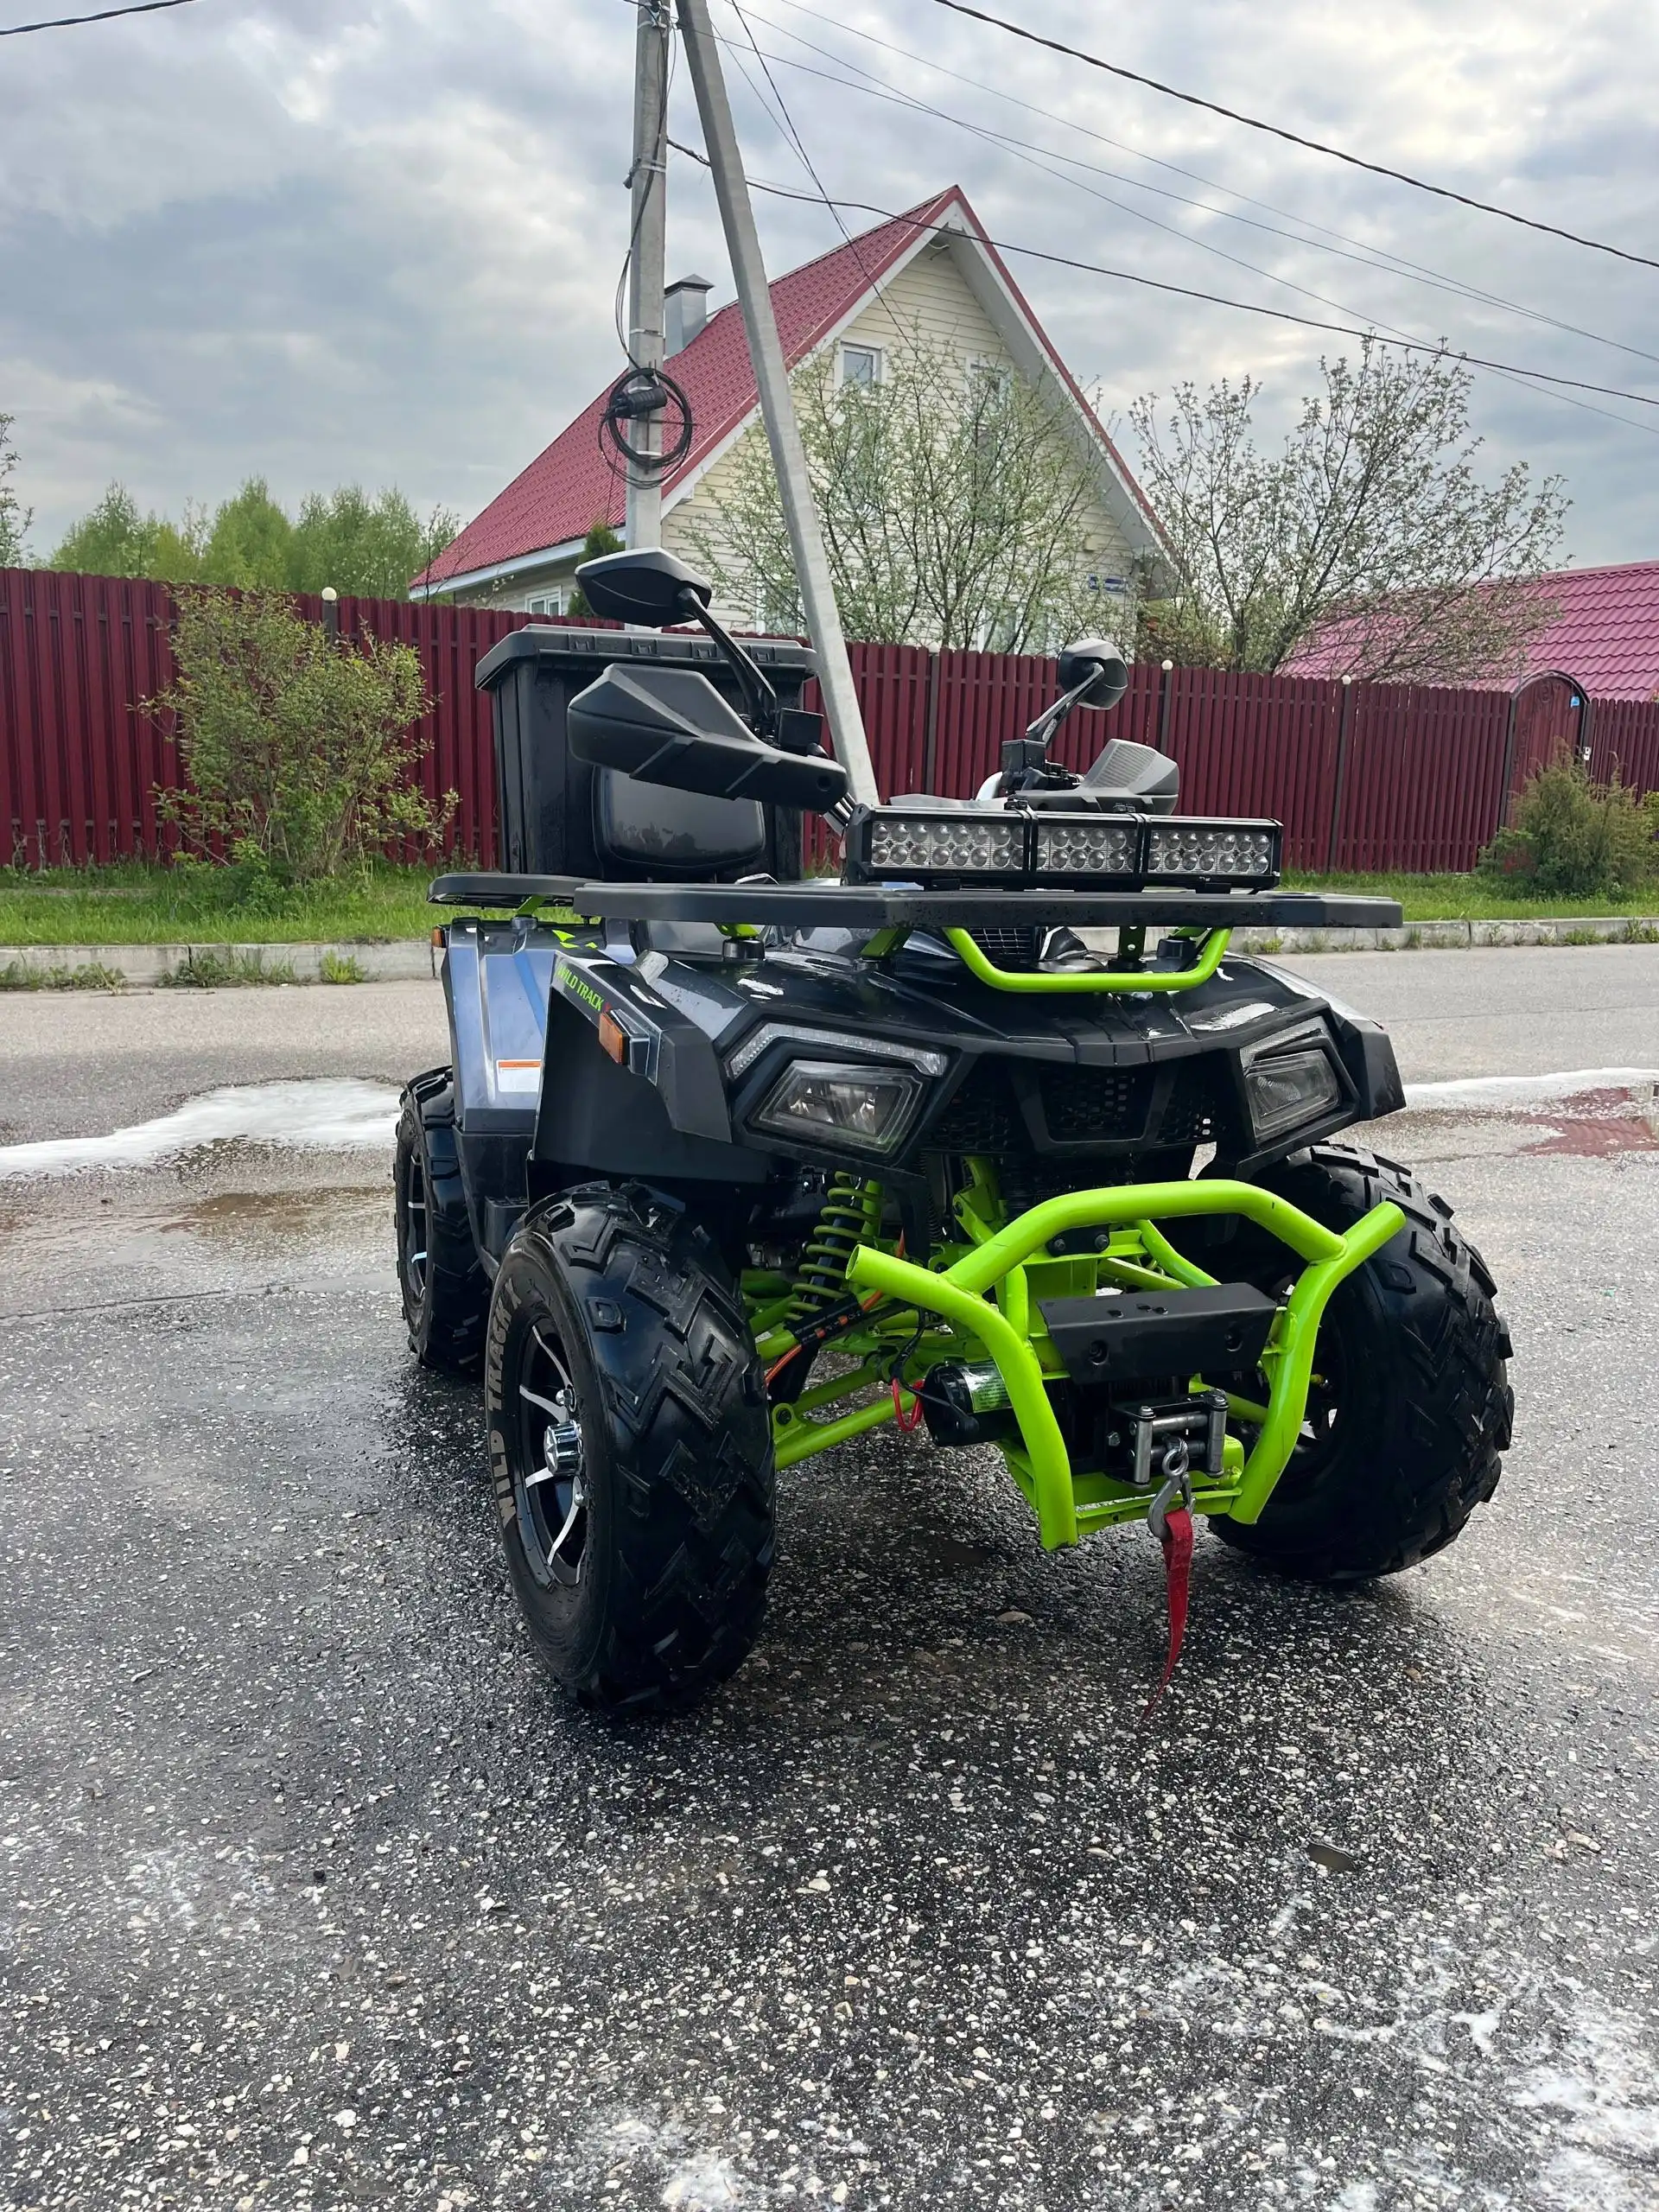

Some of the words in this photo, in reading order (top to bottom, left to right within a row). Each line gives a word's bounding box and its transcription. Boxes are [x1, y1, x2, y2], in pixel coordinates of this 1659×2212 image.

[558, 964, 578, 989] WILD
[576, 980, 604, 1012] TRACK
[505, 1278, 522, 1310] X
[487, 1295, 512, 1411] TRACK
[491, 1430, 517, 1529] WILD
